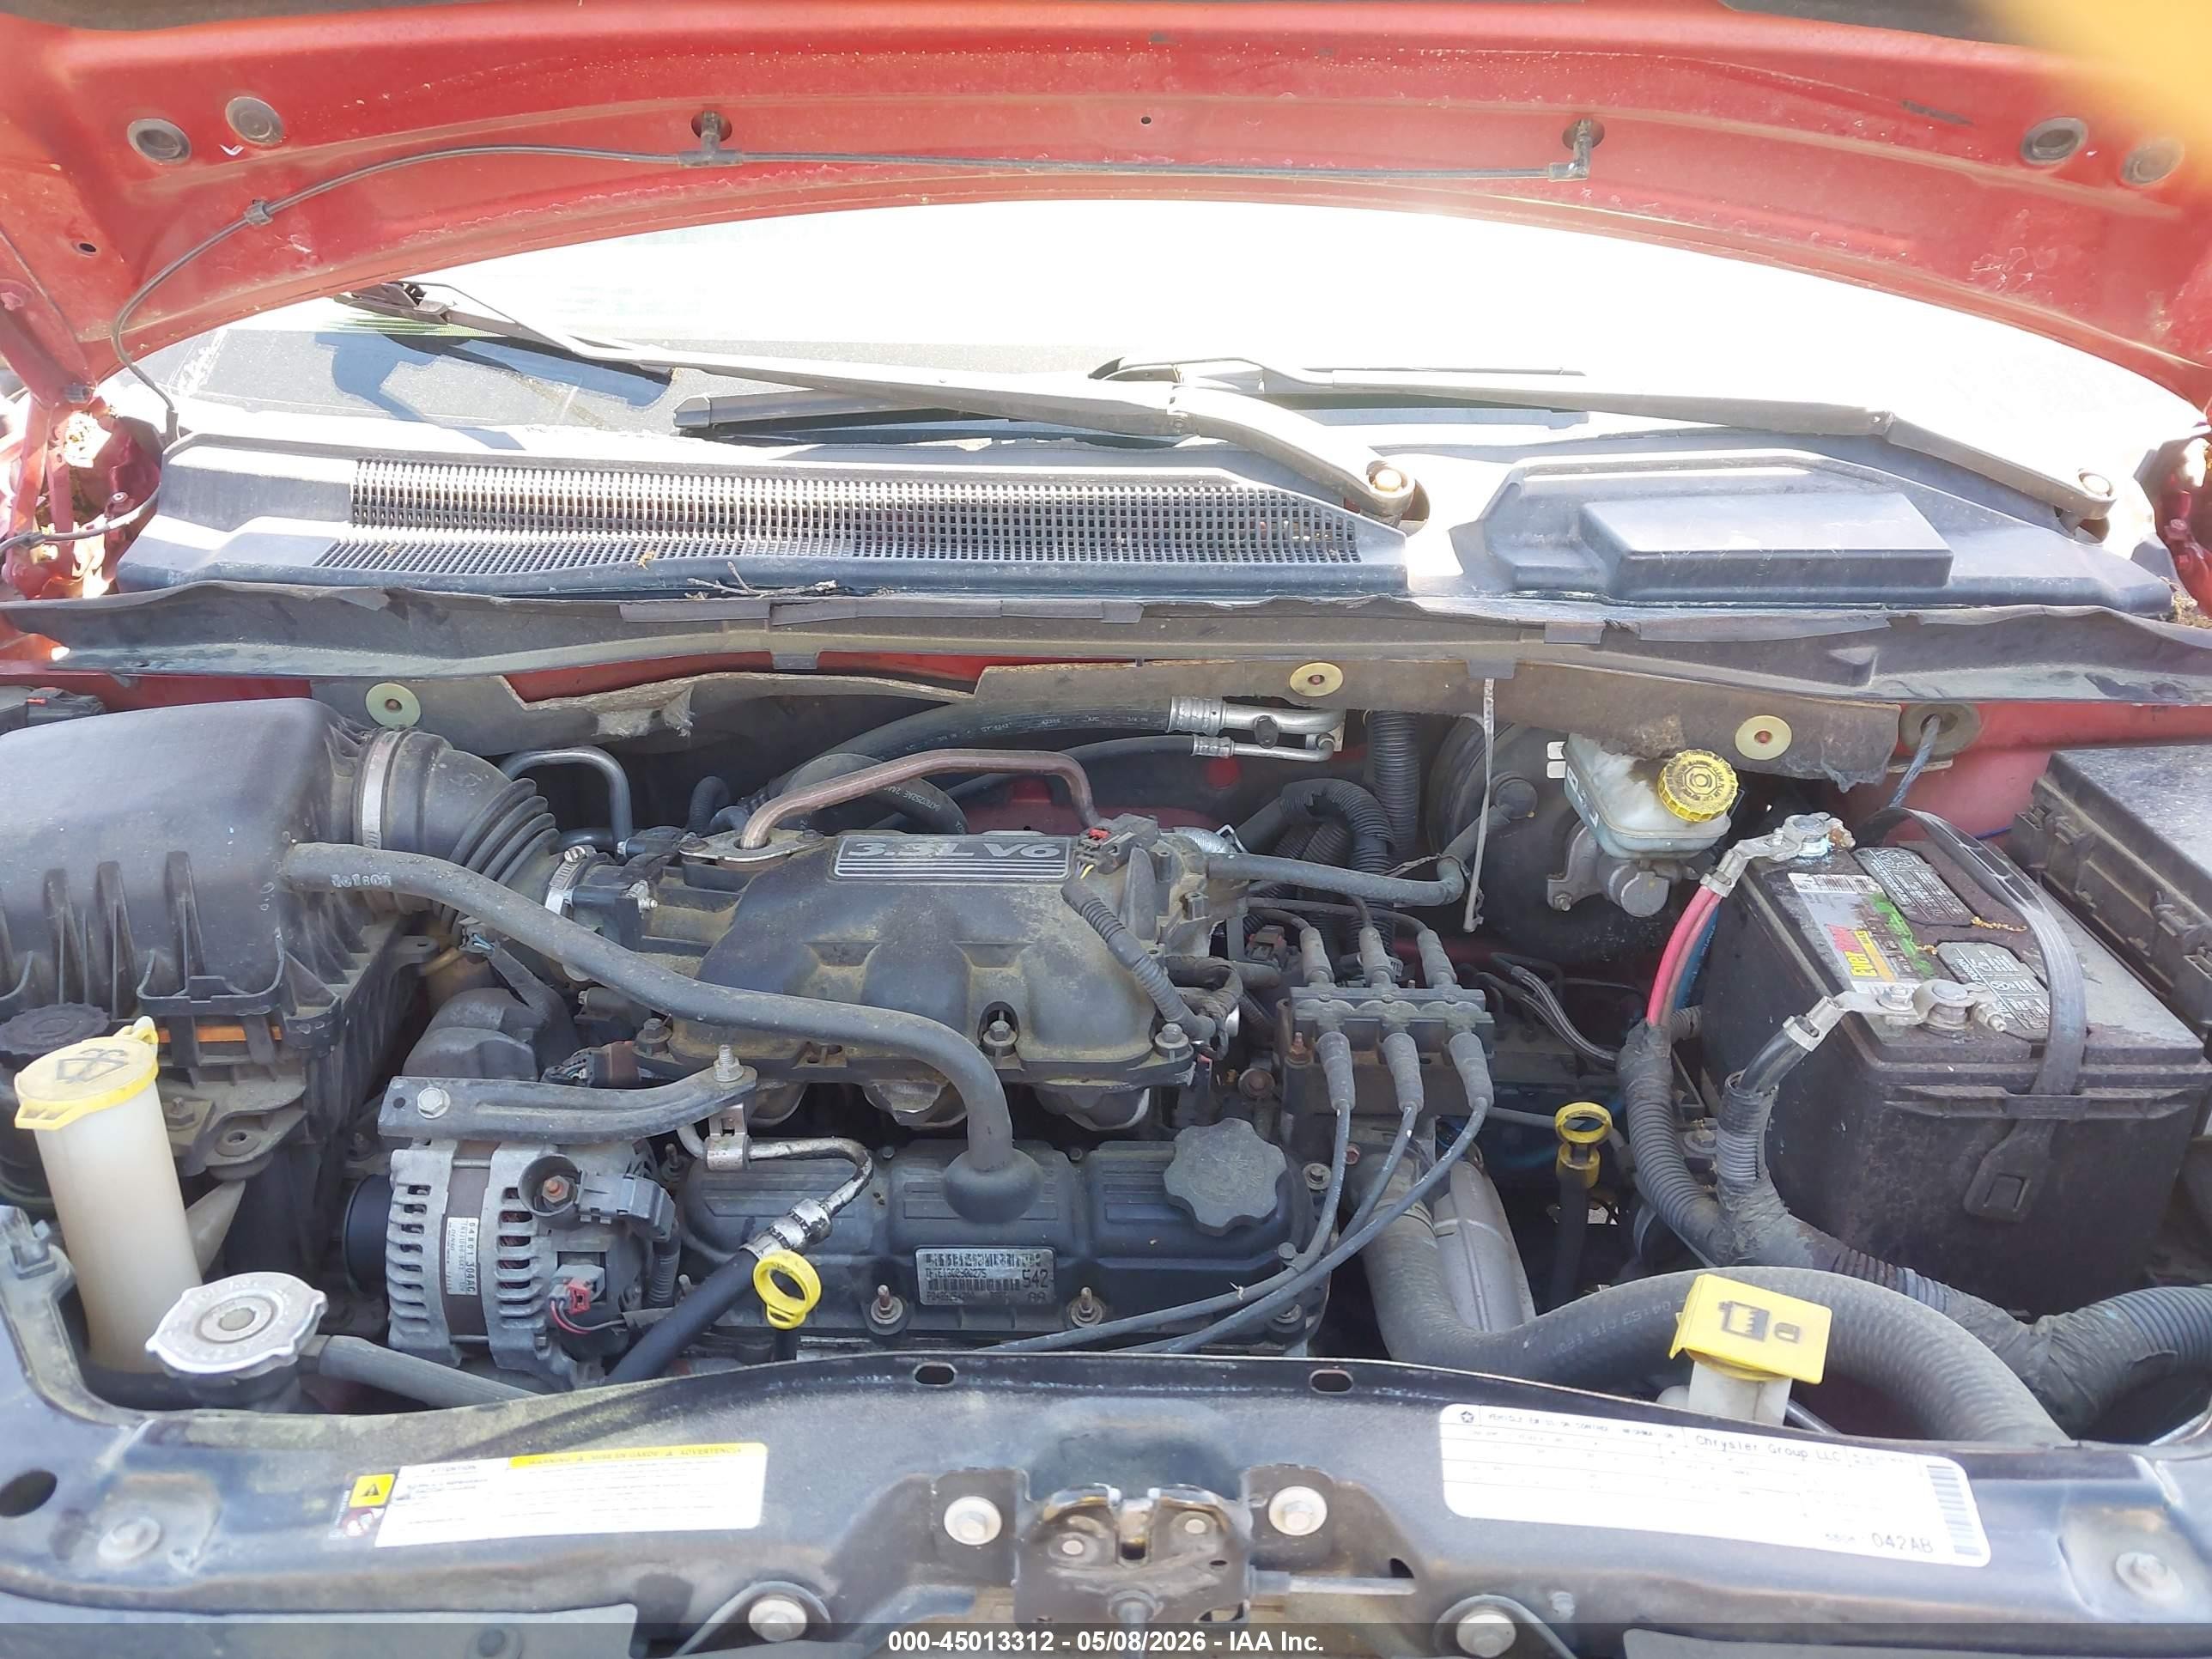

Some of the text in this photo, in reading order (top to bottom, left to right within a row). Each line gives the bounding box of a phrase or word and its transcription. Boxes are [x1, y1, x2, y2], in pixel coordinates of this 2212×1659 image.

[848, 842, 1060, 858] 3.3L V6
[1022, 1268, 1048, 1288] 542
[1695, 1434, 1758, 1453] Chrysler
[1767, 1443, 1808, 1461] Group
[1815, 1449, 1841, 1463] LLC
